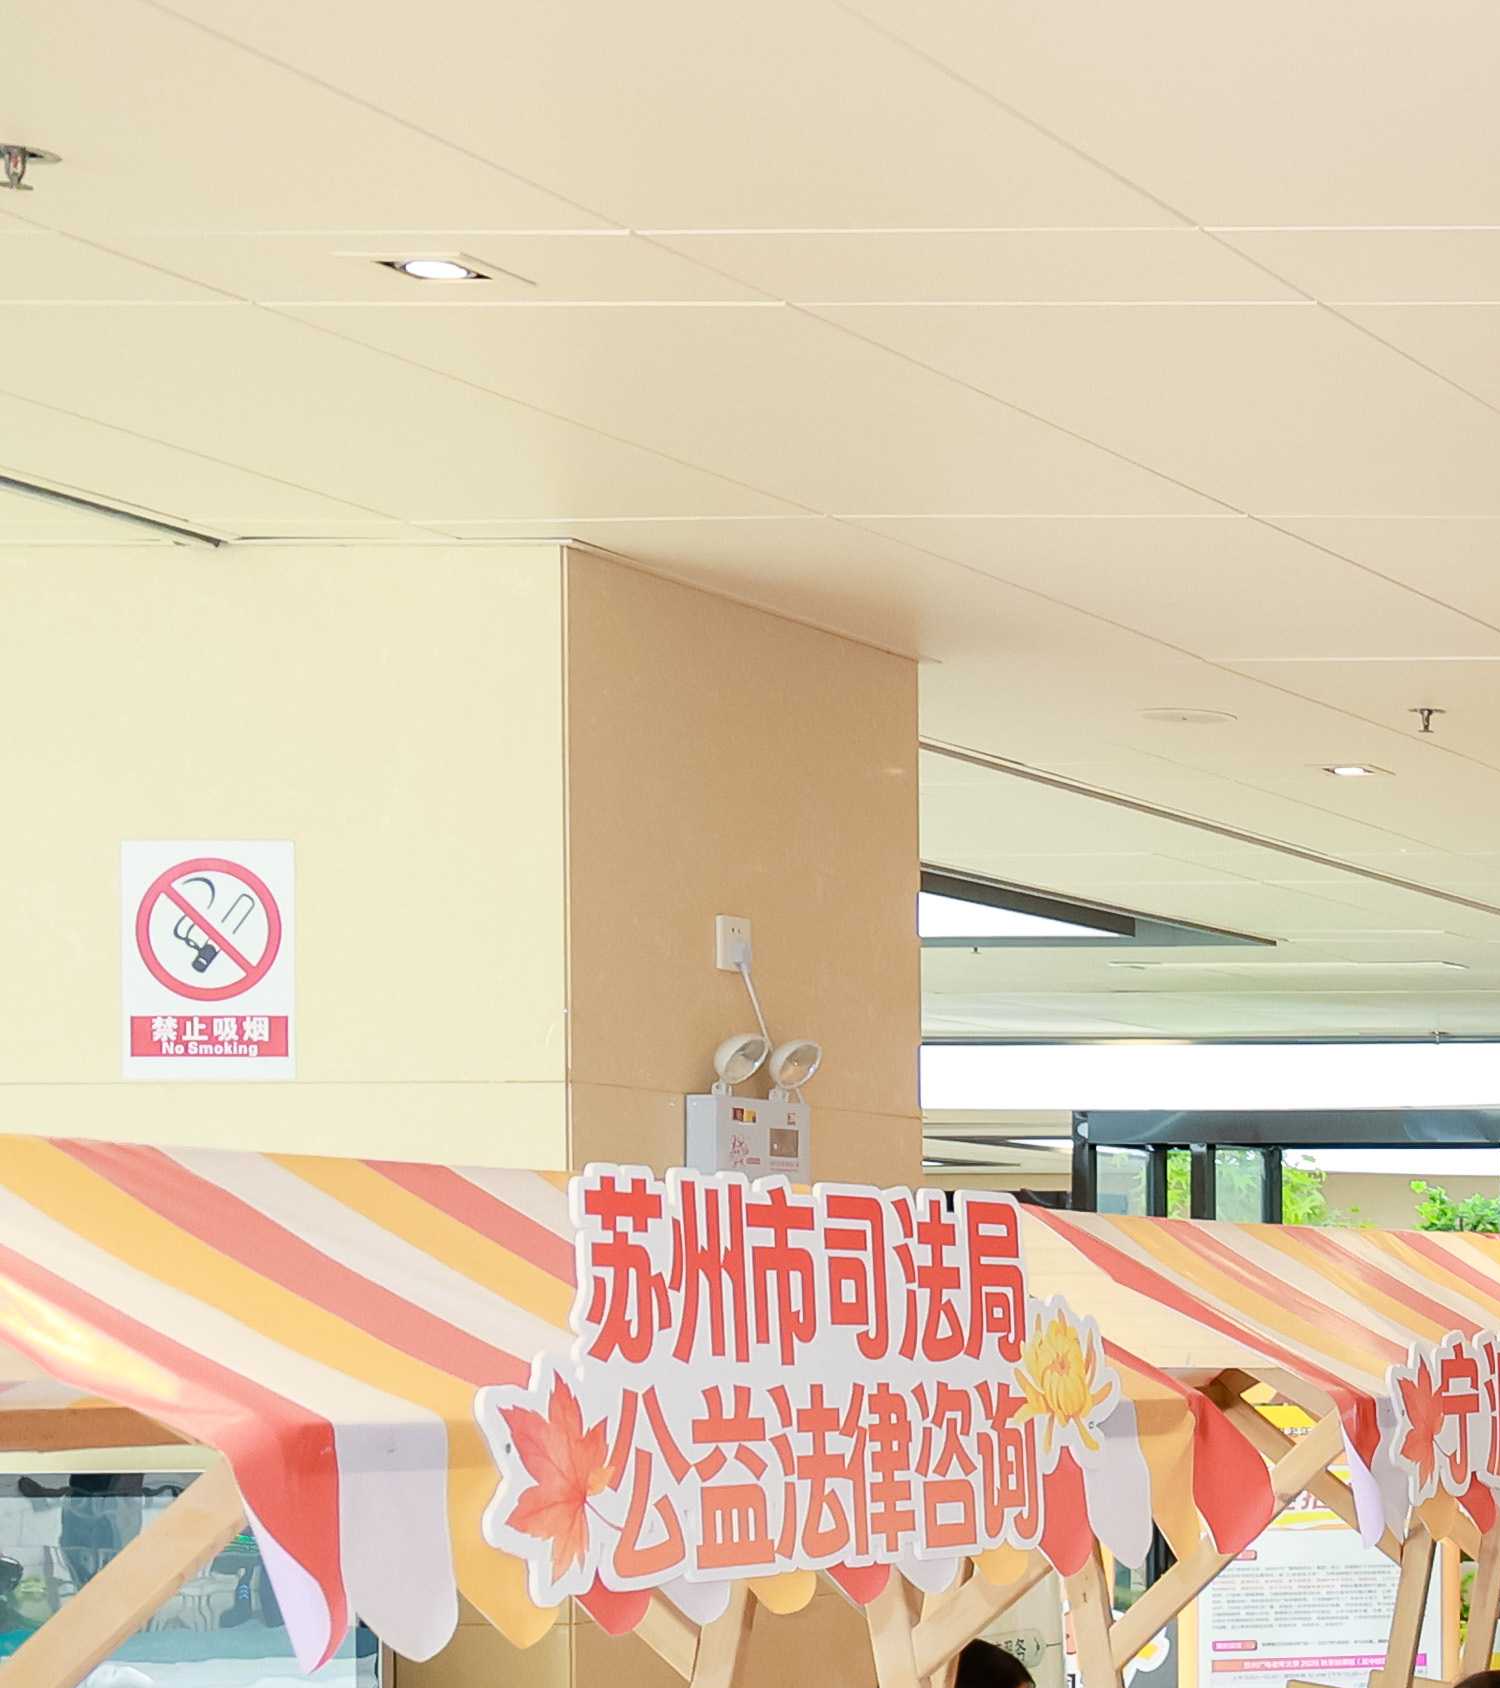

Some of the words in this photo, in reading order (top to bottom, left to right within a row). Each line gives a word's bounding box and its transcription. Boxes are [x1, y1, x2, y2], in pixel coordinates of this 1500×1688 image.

[152, 1016, 269, 1042] 禁止吸烟
[162, 1041, 184, 1054] No
[187, 1041, 258, 1056] Smoking
[583, 1176, 1029, 1367] 苏州市司法局
[604, 1380, 1045, 1580] 公益法律咨询
